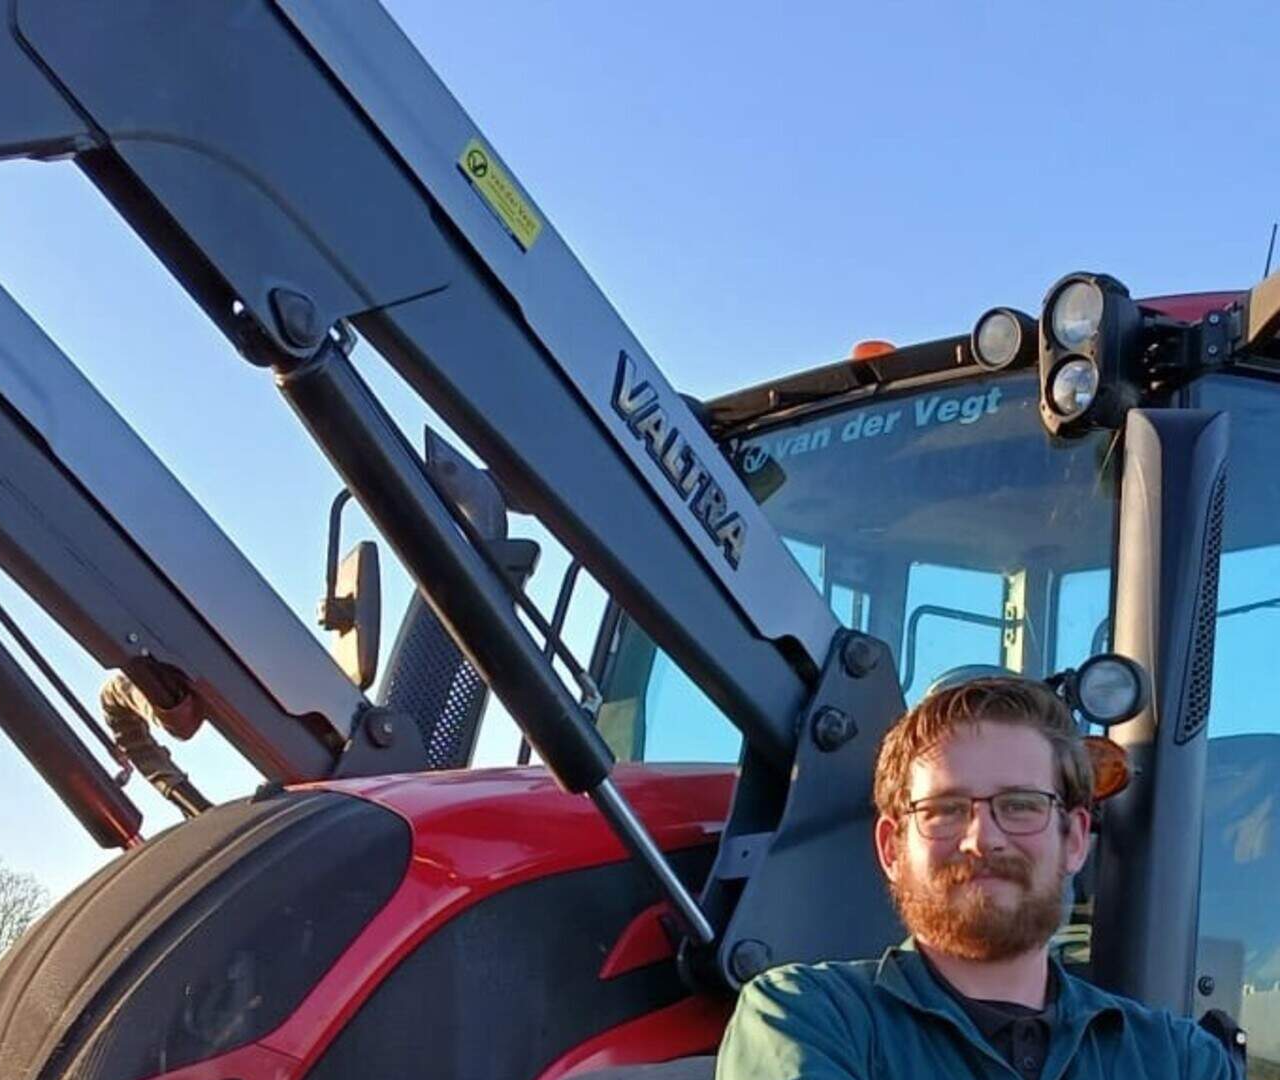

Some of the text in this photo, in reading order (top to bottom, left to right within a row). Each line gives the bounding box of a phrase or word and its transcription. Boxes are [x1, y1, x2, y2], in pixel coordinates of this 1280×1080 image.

[612, 350, 748, 571] VALTRA
[775, 386, 1002, 460] van der Vegt
